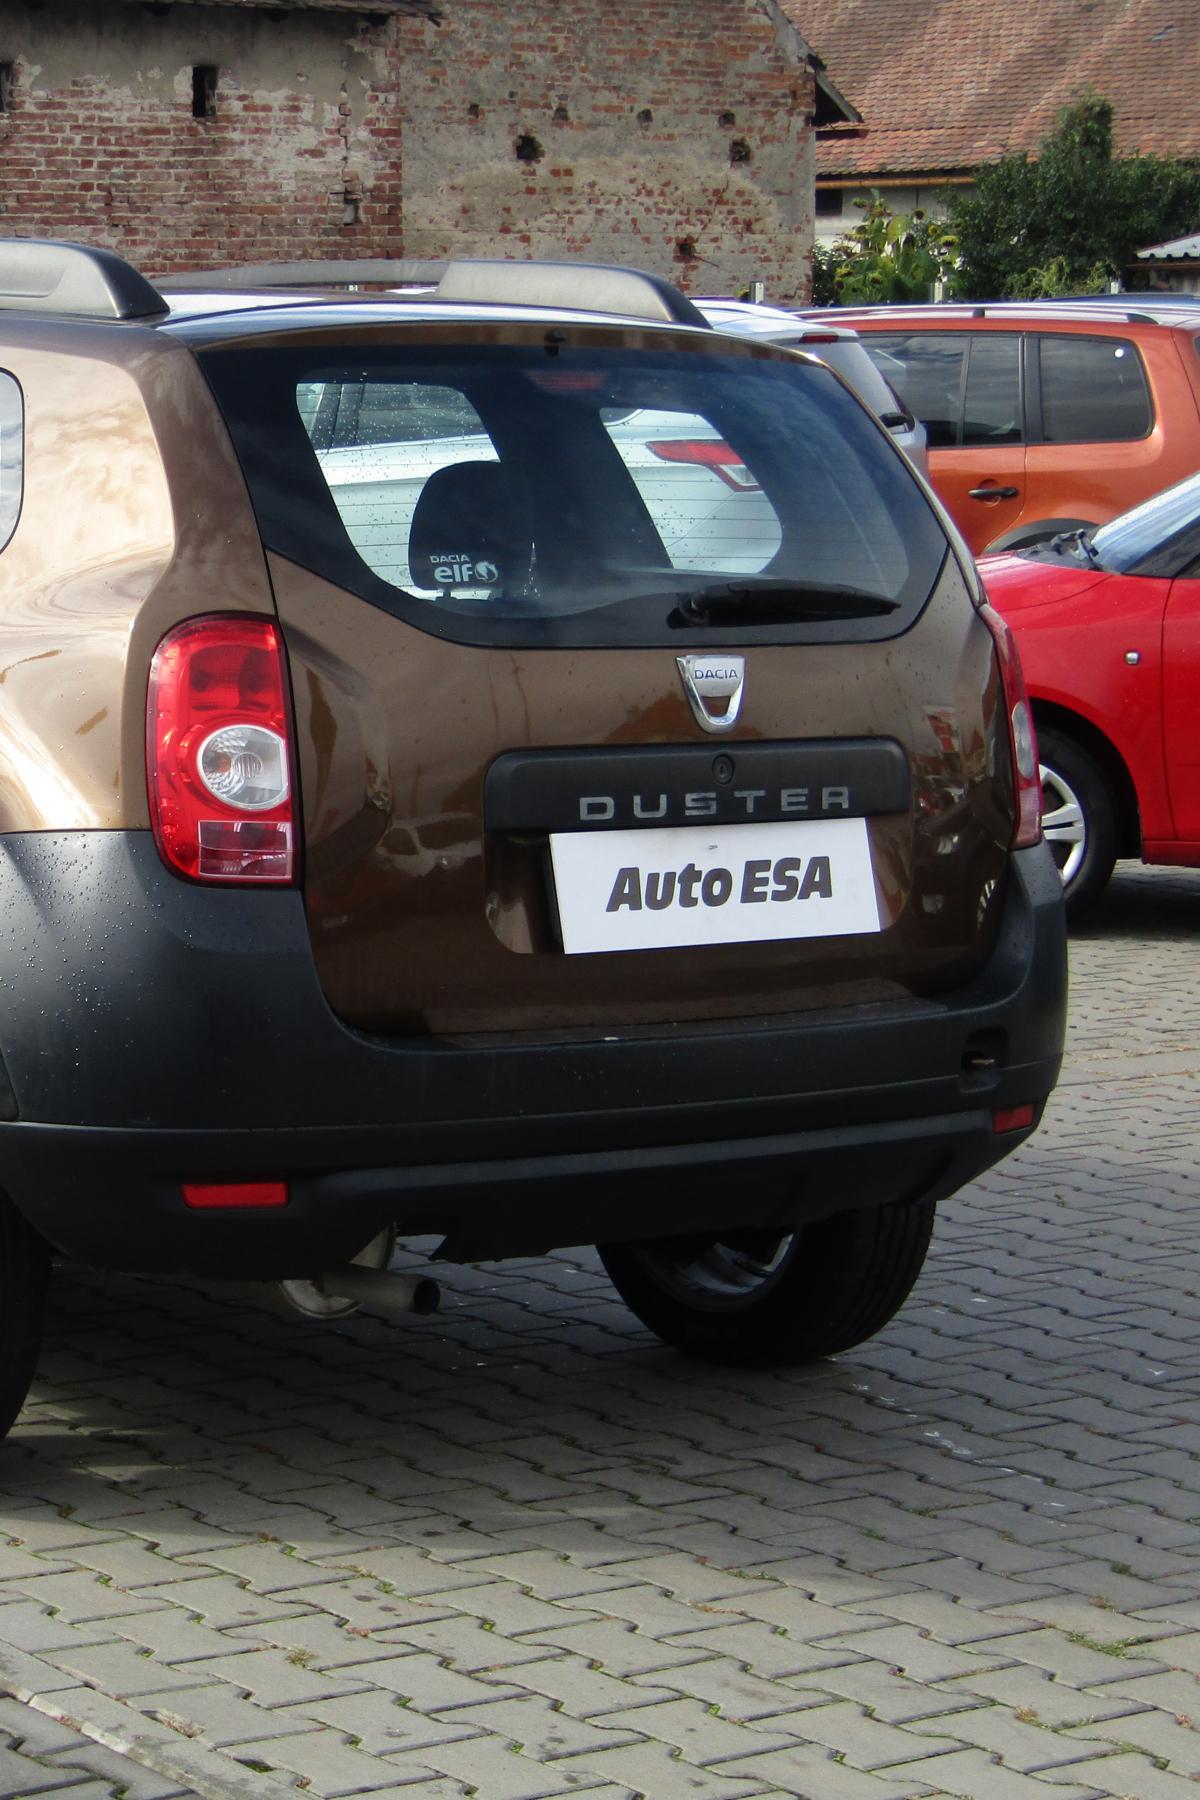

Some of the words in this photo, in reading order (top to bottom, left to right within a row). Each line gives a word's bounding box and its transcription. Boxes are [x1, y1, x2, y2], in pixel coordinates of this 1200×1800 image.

[429, 554, 471, 563] DACIA
[434, 563, 473, 583] elf
[693, 669, 738, 680] DACIA
[579, 786, 850, 821] DUSTER
[605, 862, 733, 912] Auto
[740, 855, 833, 904] ESA
